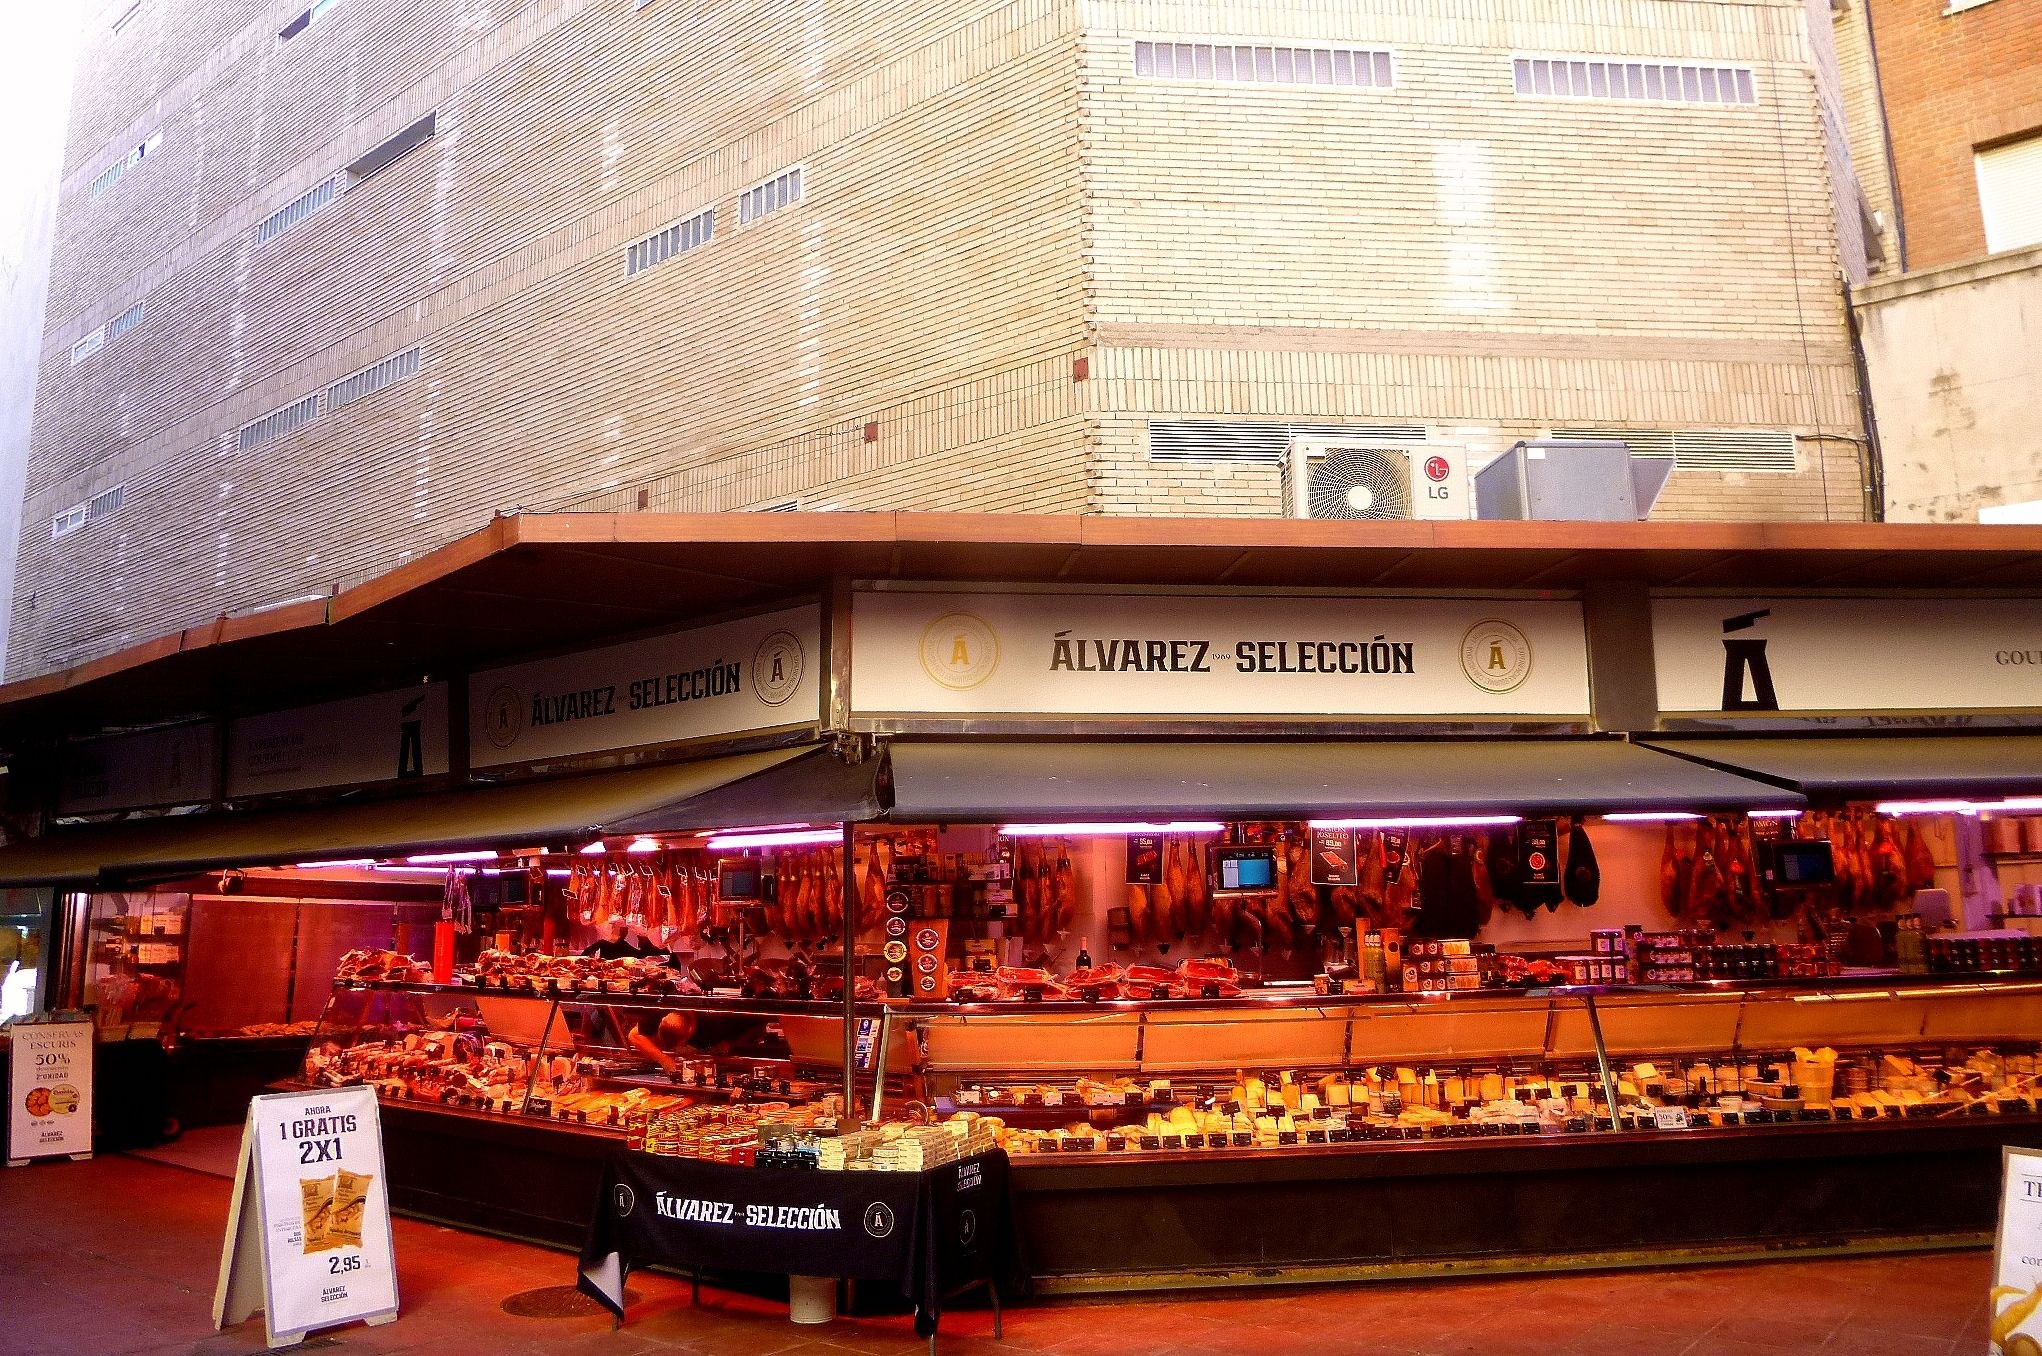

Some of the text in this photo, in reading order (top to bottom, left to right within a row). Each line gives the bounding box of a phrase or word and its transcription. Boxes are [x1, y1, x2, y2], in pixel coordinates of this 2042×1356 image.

[1428, 486, 1449, 499] LG
[1049, 629, 1211, 673] ÁLVAREZ
[1235, 635, 1415, 674] SELECCIÓN
[1488, 639, 1507, 669] Á
[770, 650, 784, 682] Á
[530, 691, 616, 727] ÁLVAREZ
[629, 658, 741, 710] SELECCIÓN
[22, 1030, 85, 1040] CONSERVAS
[30, 1040, 77, 1049] ESCURIS
[35, 1053, 70, 1066] 50%
[304, 1105, 332, 1116] AHORA
[279, 1115, 357, 1140] 1 GRATIS
[299, 1137, 343, 1164] 2X1
[655, 1191, 842, 1231] ÁLVAREZ SELECCIÓN
[329, 1255, 361, 1275] 2,95
[320, 1291, 348, 1303] SELECCIÓN
[322, 1285, 346, 1296] ÁLVAREZ
